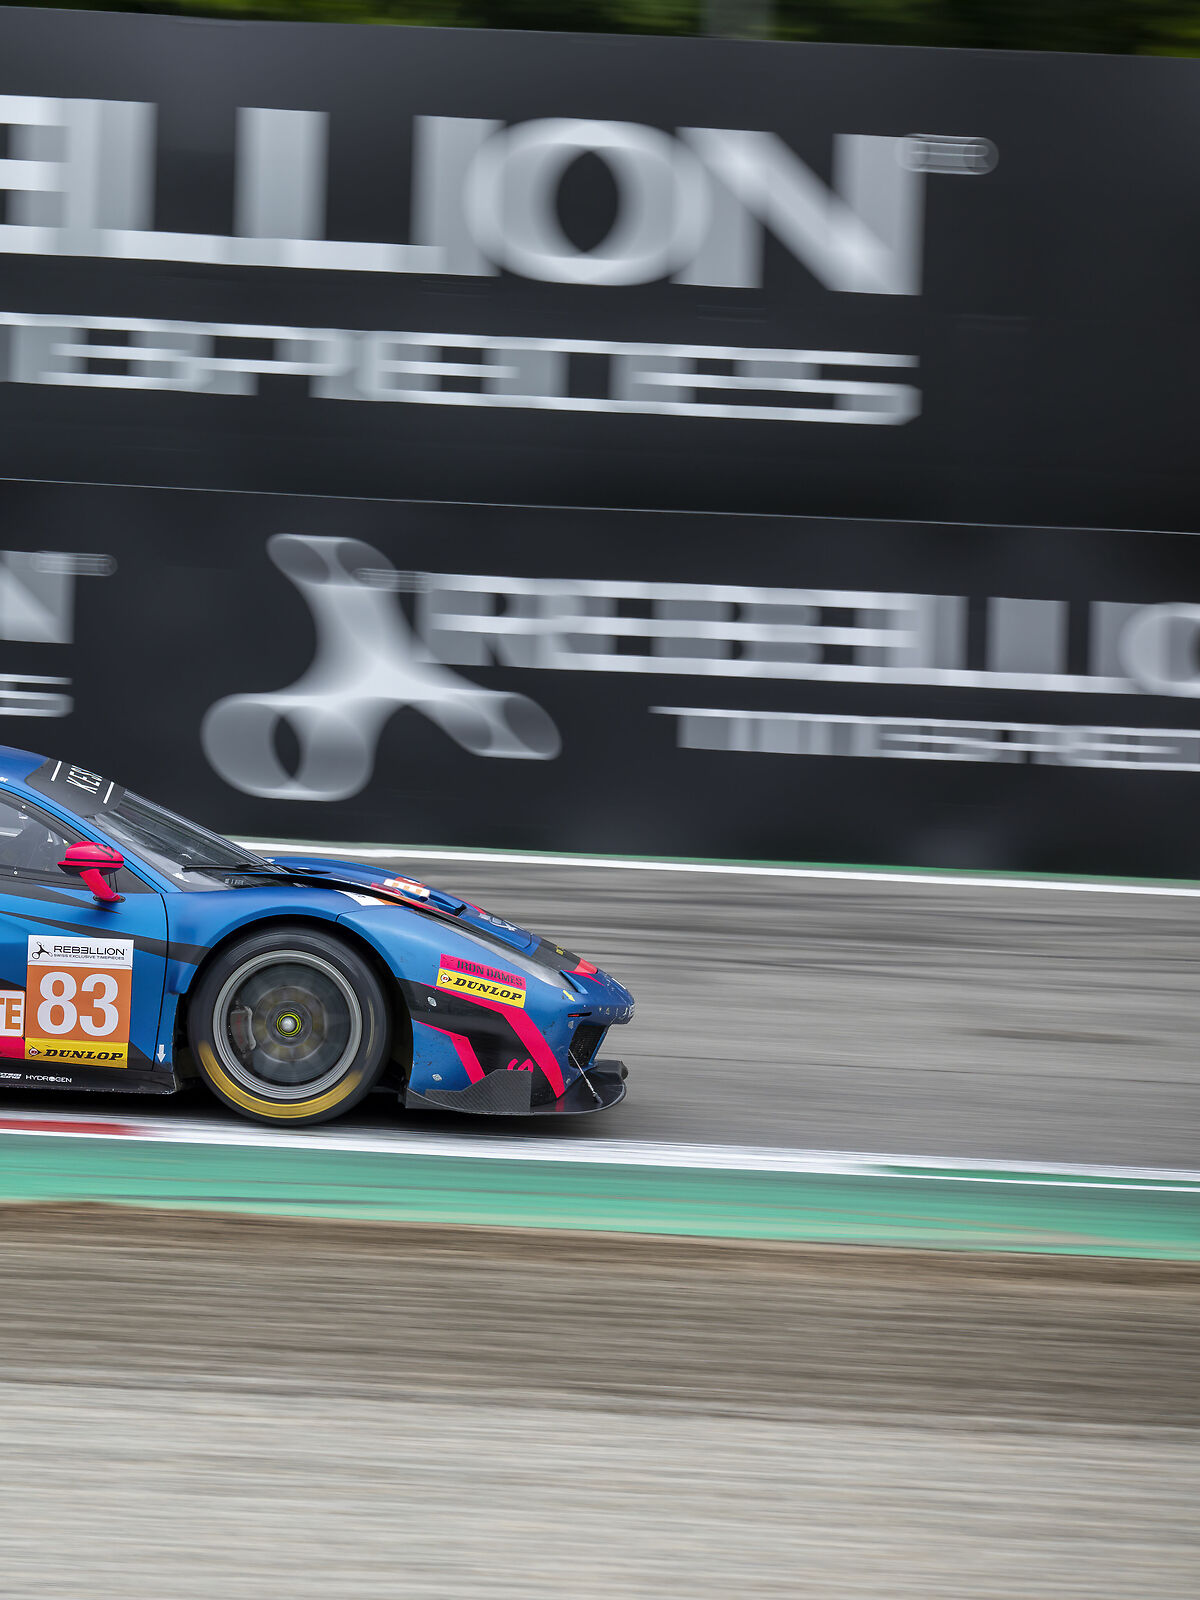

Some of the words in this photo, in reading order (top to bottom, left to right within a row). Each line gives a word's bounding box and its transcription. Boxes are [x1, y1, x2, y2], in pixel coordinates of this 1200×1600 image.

[53, 945, 125, 956] REBELLION
[457, 960, 484, 975] IRON
[486, 968, 523, 986] DAMES
[453, 977, 523, 1001] DUNLOP
[37, 971, 119, 1037] 83
[43, 1048, 123, 1061] DUNLOP
[25, 1074, 72, 1083] HYDROGEN
